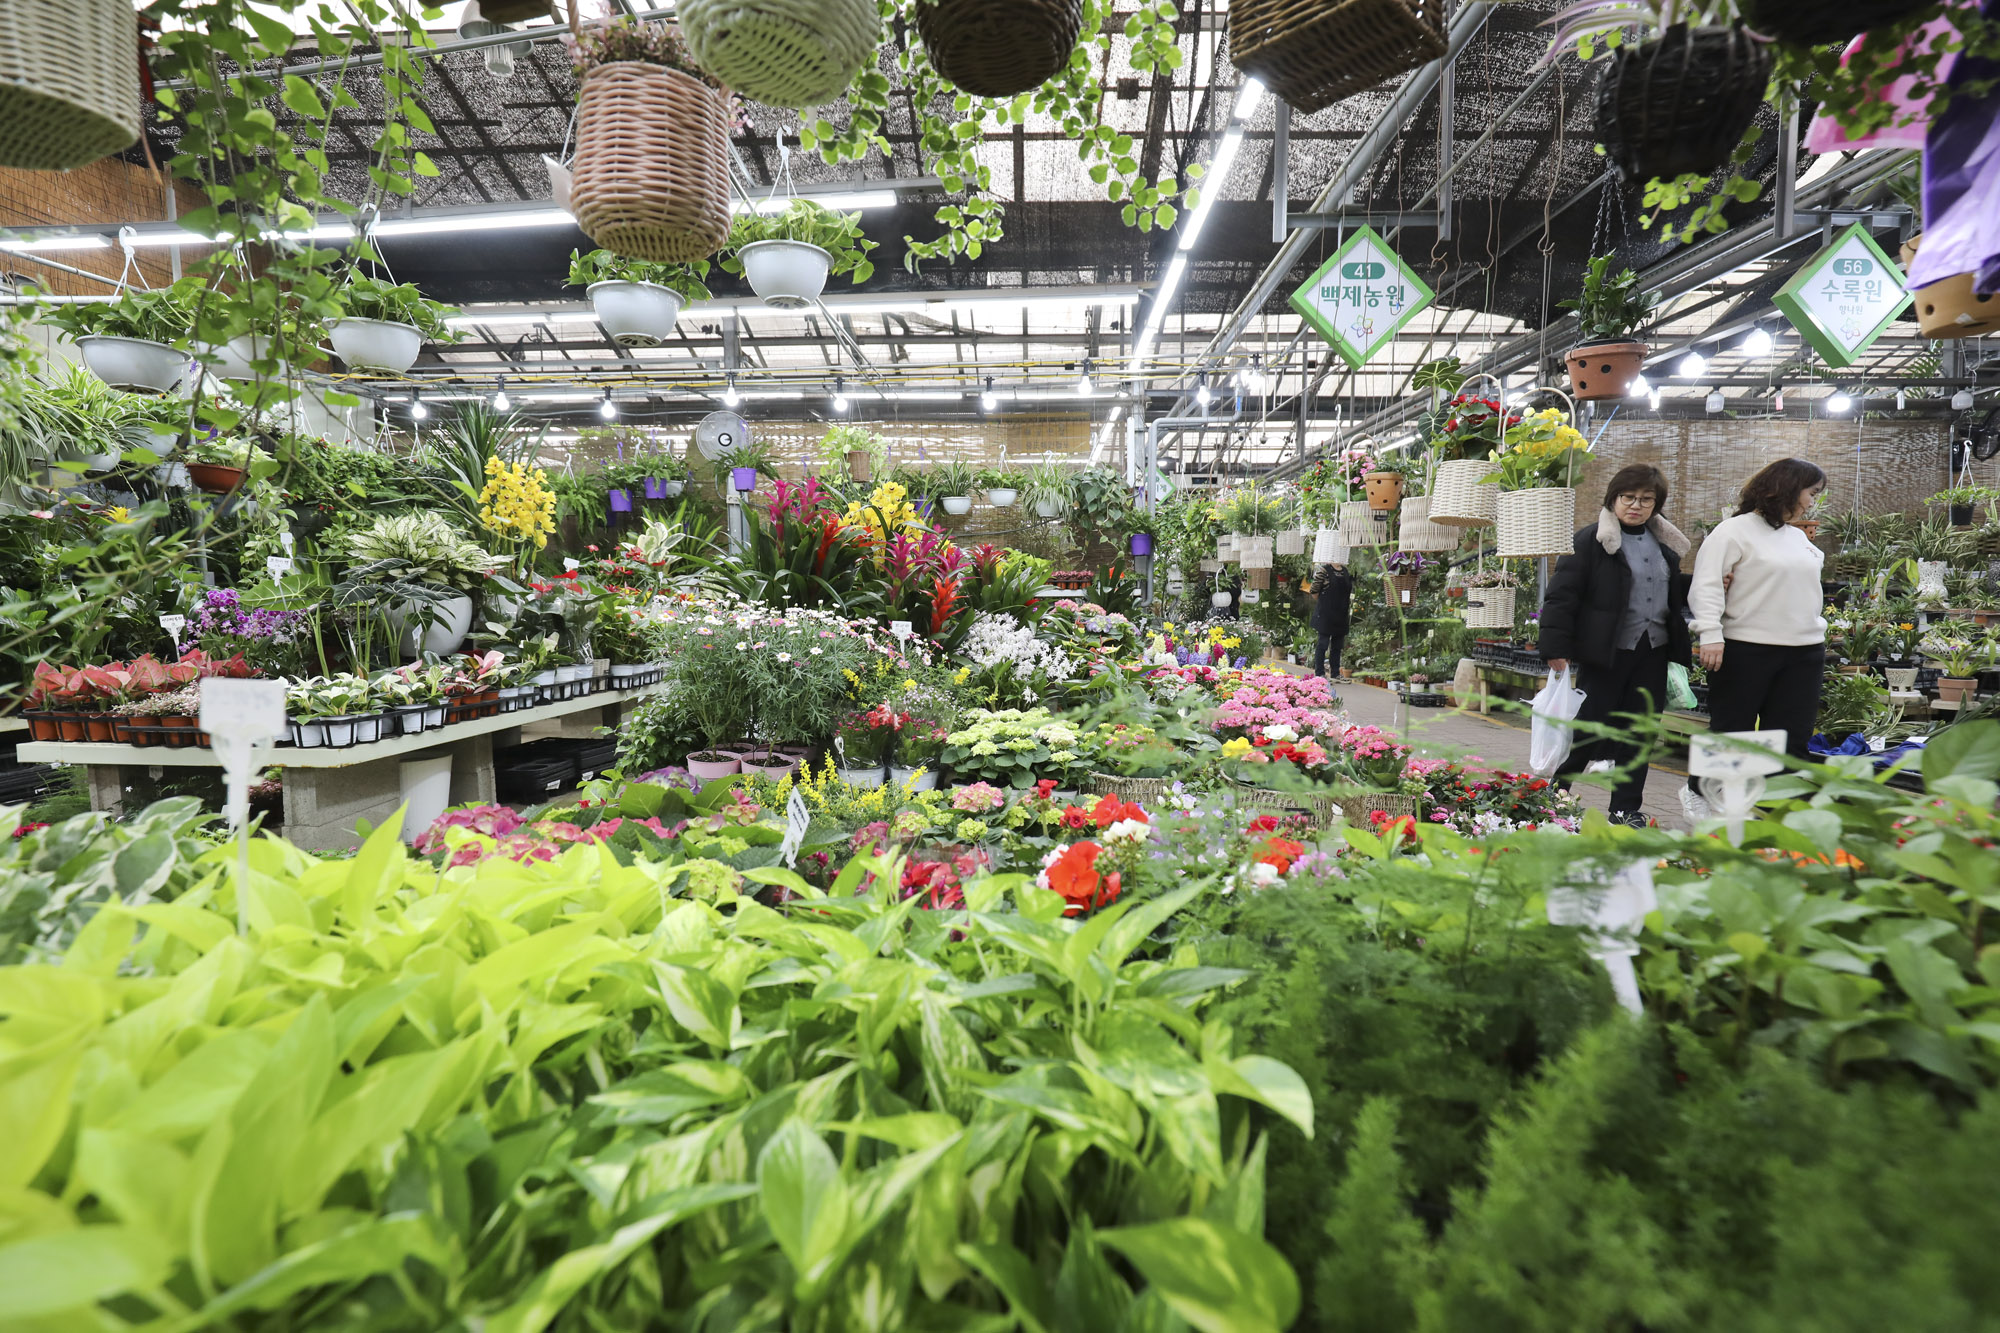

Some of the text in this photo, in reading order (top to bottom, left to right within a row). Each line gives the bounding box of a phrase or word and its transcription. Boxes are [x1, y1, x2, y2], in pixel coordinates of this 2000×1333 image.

[1353, 263, 1372, 278] 41
[1843, 260, 1863, 274] 56
[1321, 285, 1405, 308] 백제농원
[1821, 279, 1882, 303] 수록원
